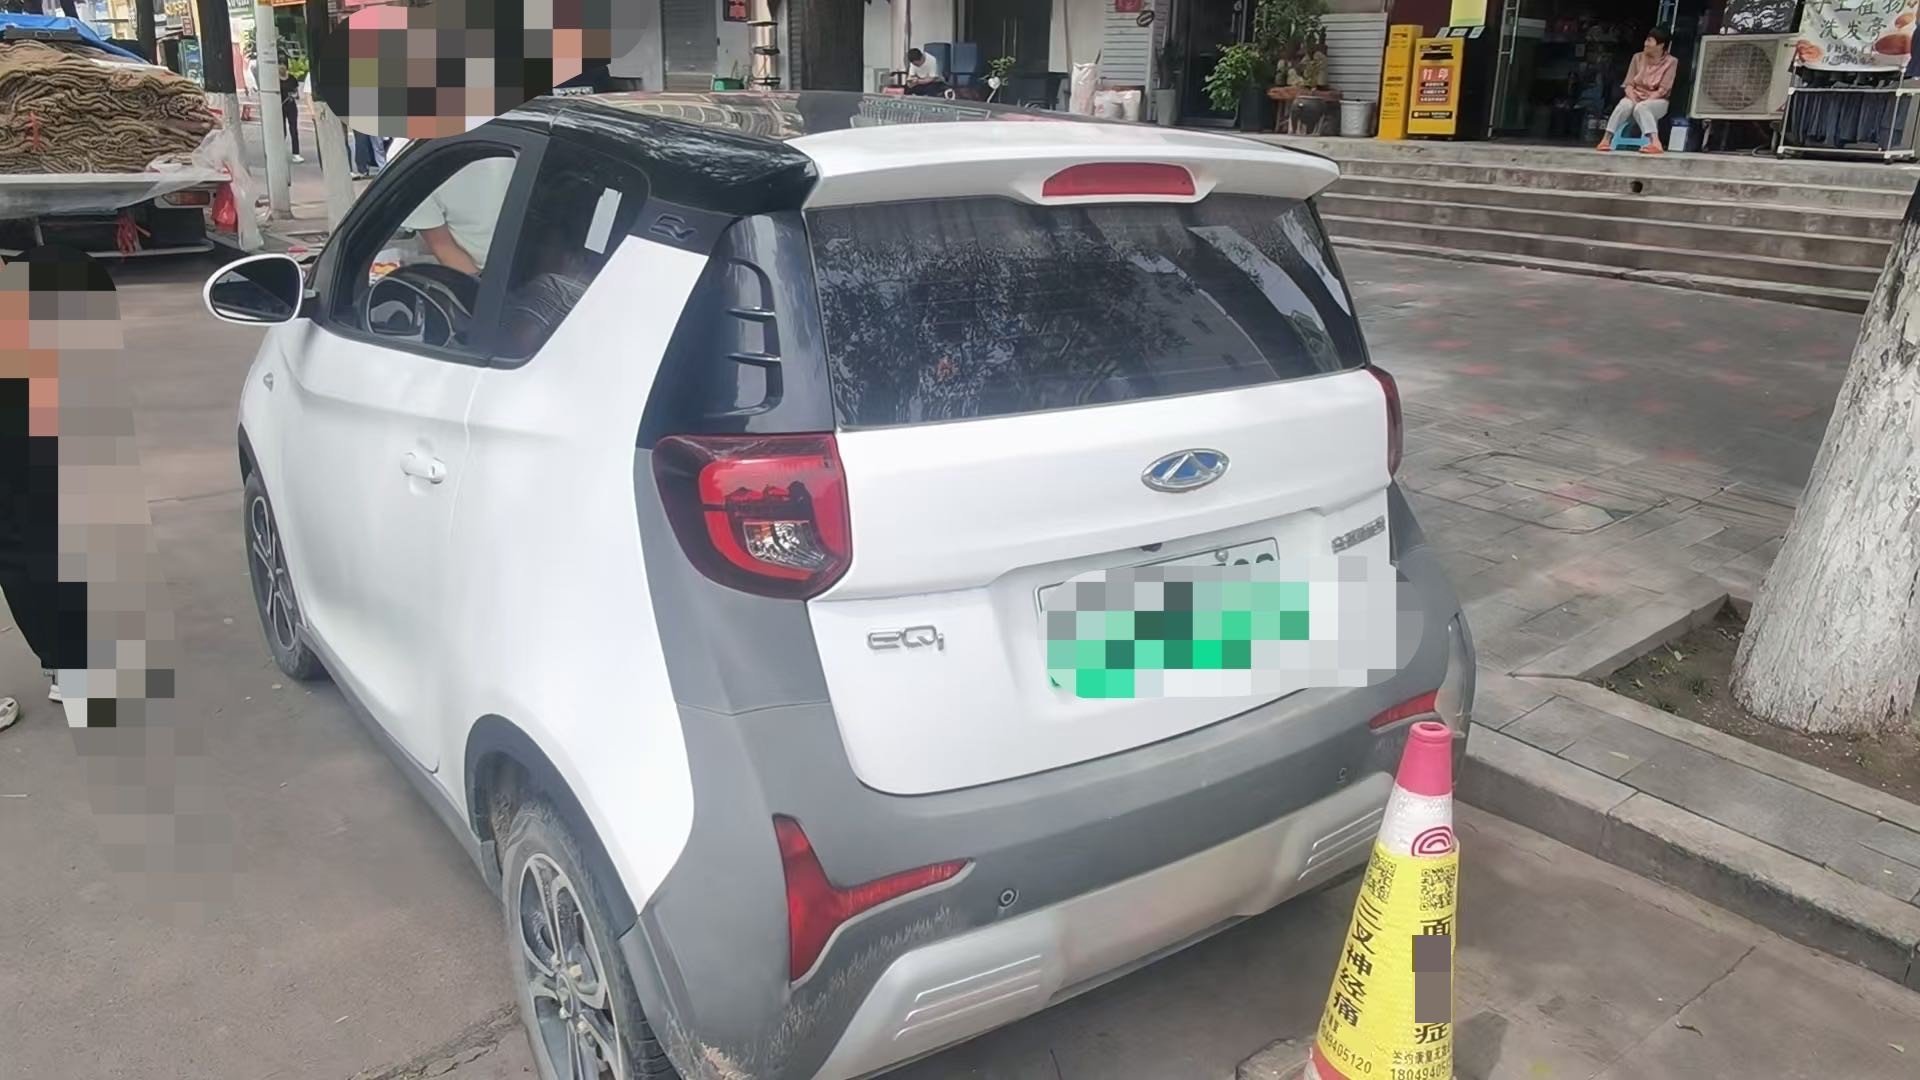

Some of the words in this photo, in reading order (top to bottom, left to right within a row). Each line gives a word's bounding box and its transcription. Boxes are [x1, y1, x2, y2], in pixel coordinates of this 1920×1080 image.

[1333, 895, 1382, 1027] 三叉神经痛
[1320, 1018, 1373, 1074] 49405120
